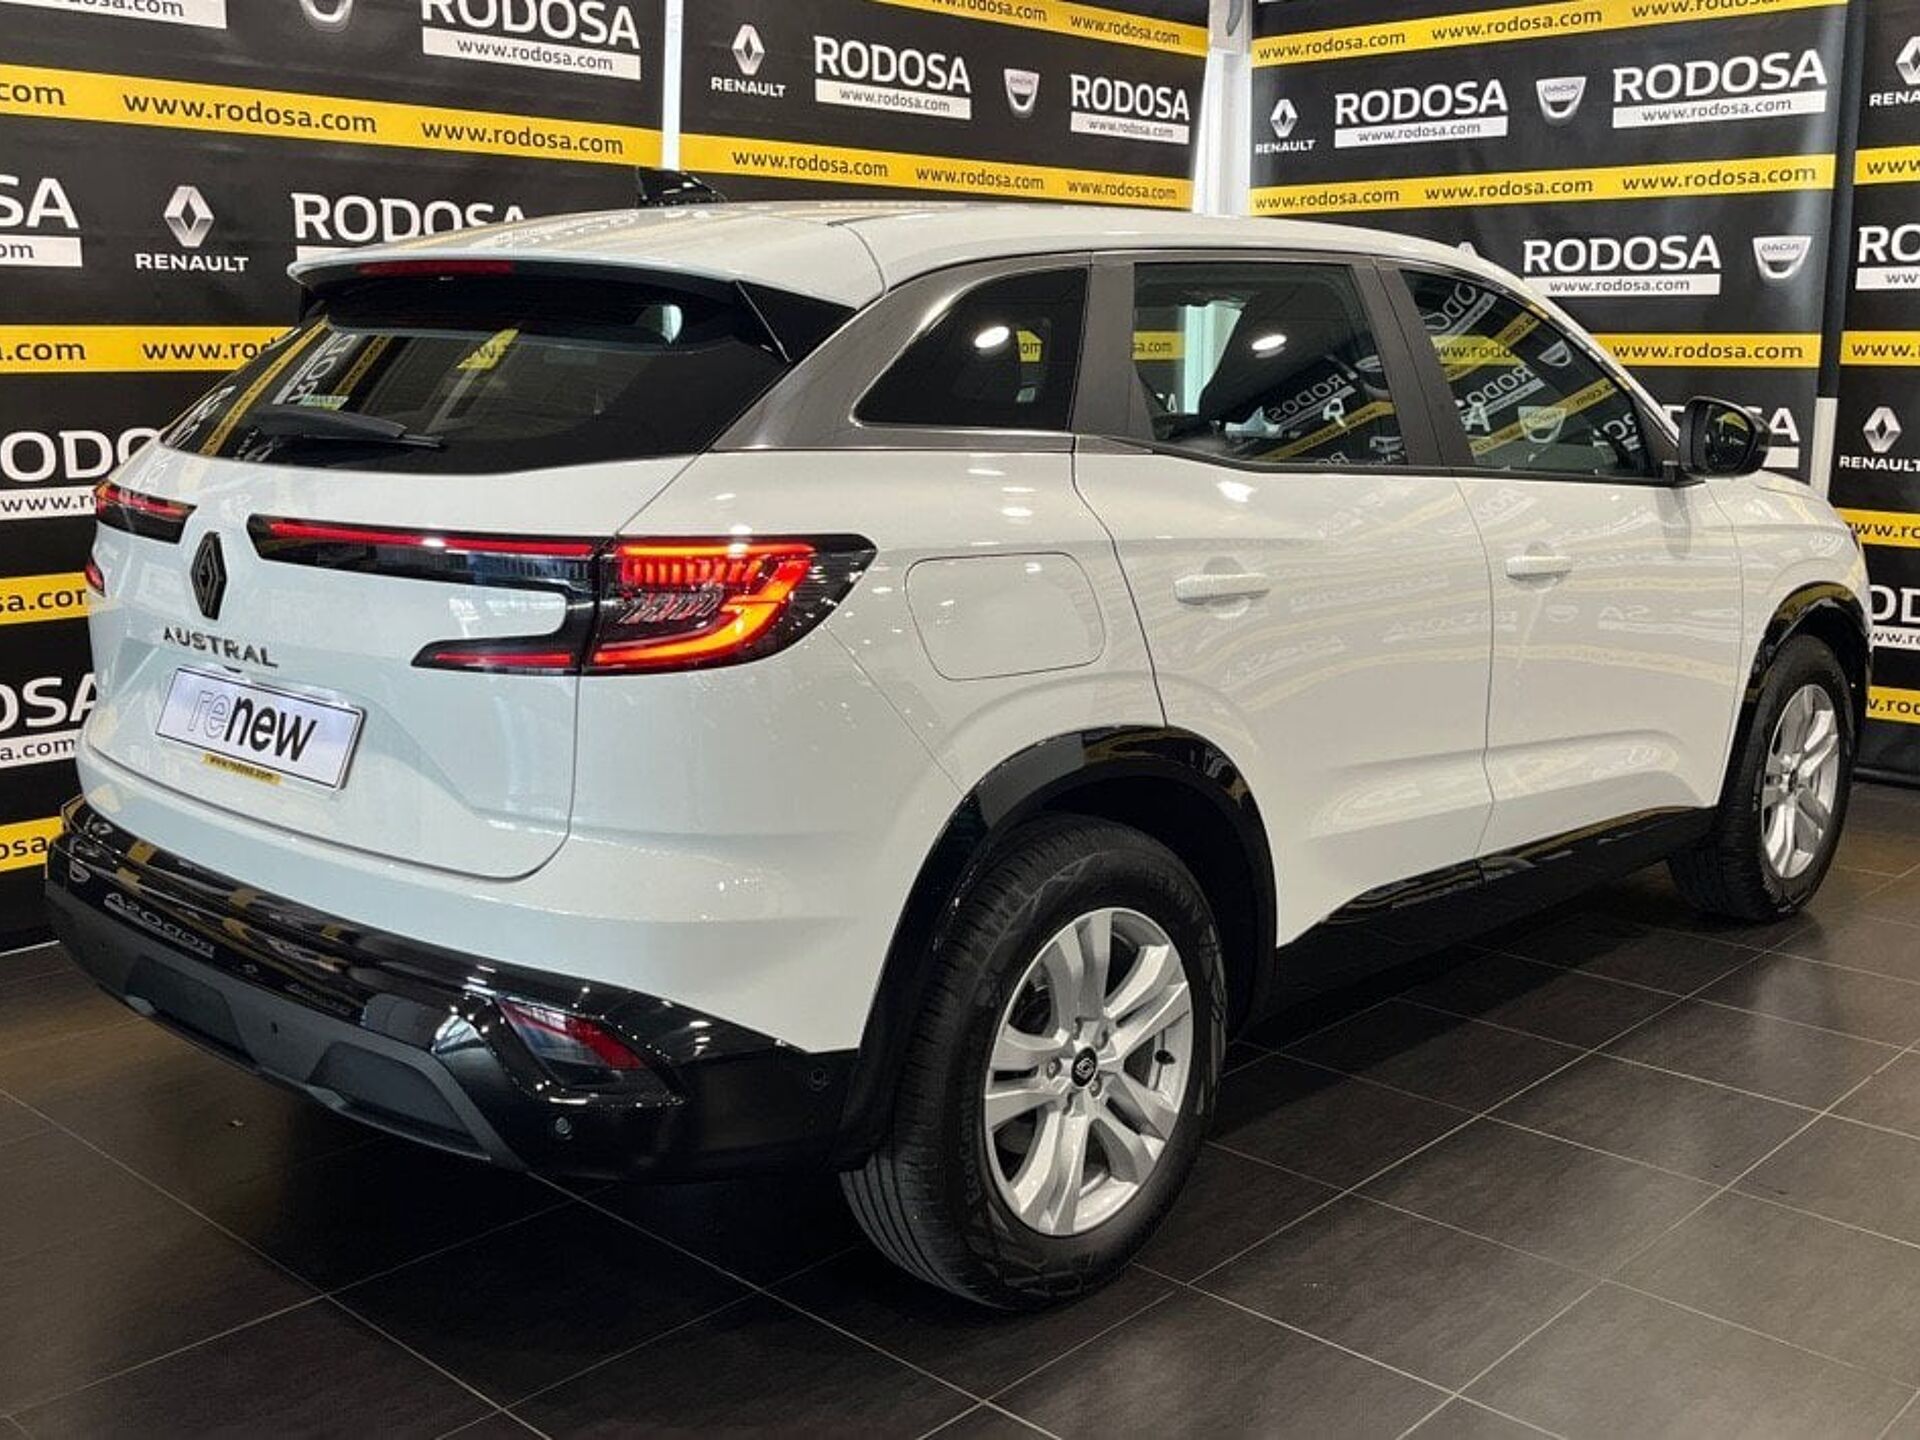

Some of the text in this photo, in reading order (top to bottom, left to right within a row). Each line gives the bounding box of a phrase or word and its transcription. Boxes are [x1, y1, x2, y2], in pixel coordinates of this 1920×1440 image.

[1070, 13, 1180, 44] www.rodosa.com
[1259, 36, 1406, 59] www.rodosa.com
[1431, 10, 1603, 40] www.rodosa.com
[457, 39, 613, 71] www.rodosa.com
[814, 35, 971, 93] RODOSA
[711, 77, 786, 97] RENAULT
[1613, 49, 1827, 102] RODOSA
[840, 87, 950, 112] www.rodosa.com
[1070, 74, 1190, 121] RODOSA
[1335, 79, 1508, 125] RODOSA
[1642, 98, 1791, 122] www.rodosa.com
[123, 94, 377, 134] www.rodosa.com
[422, 122, 623, 154] www.rodosa.com
[1089, 119, 1173, 138] www.rodosa.com
[1358, 124, 1480, 143] www.rodosa.com
[1256, 140, 1315, 154] RENAULT
[733, 151, 1176, 200] www.rodosa.com www.rodosa.com www.rodosa.com
[1256, 166, 1816, 209] www.rodosa.com www.rodosa.com www.rodosa.com
[135, 253, 249, 273] RENAULT
[1523, 235, 1720, 272] RODOSA
[1549, 272, 1690, 293] www.rodosa.com
[1613, 341, 1804, 360] www.rodosa.com
[163, 626, 279, 668] AUSTRAL
[188, 690, 318, 762] renew
